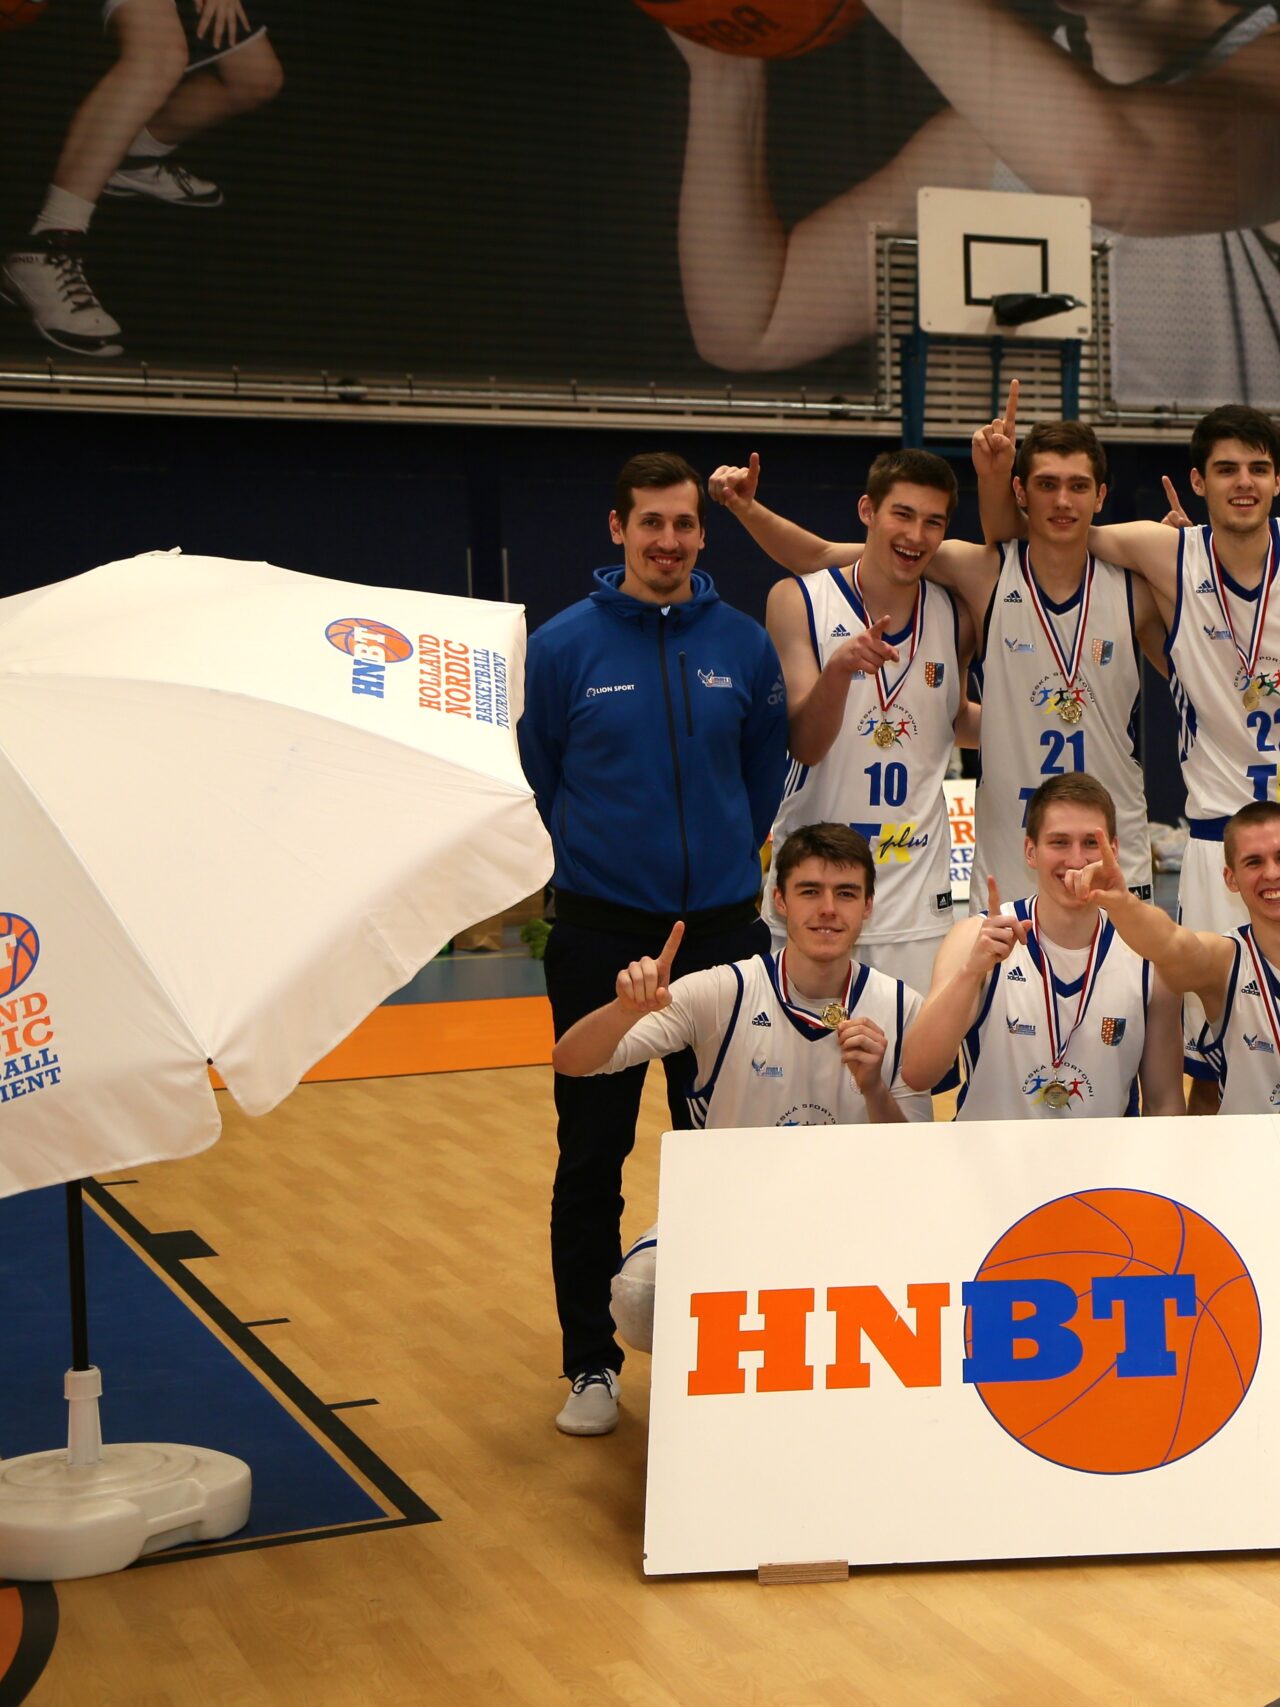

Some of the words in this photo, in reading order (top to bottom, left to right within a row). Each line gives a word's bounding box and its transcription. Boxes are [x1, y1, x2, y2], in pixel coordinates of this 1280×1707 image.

[352, 625, 386, 699] HNBT
[418, 633, 441, 712] HOLLAND
[443, 639, 473, 719] NORDIC
[473, 648, 493, 724] BASKETBALL
[493, 651, 510, 730] TOURNAMENT
[614, 684, 635, 692] SPORT
[863, 761, 908, 807] 10
[1039, 729, 1085, 775] 21
[880, 826, 929, 859] plus
[1007, 975, 1027, 983] adidas
[687, 1274, 1197, 1397] HNBT
